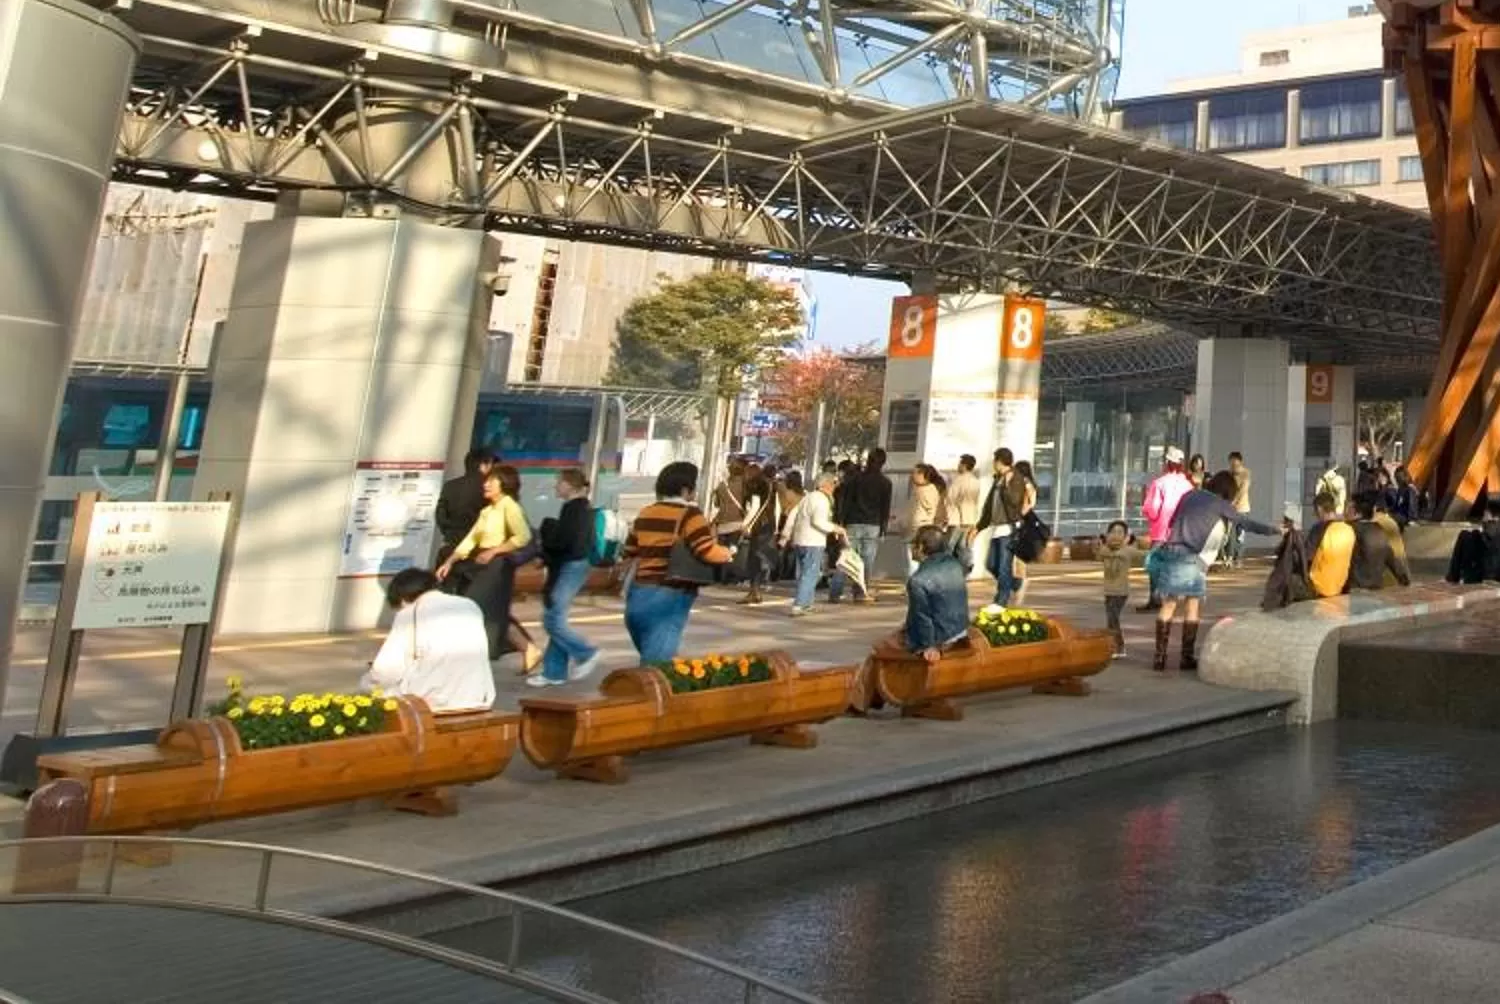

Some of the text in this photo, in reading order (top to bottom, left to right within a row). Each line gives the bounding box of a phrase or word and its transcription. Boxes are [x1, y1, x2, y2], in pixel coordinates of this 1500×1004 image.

[902, 305, 924, 347] 8
[1012, 307, 1033, 348] 8
[1311, 371, 1328, 396] 9
